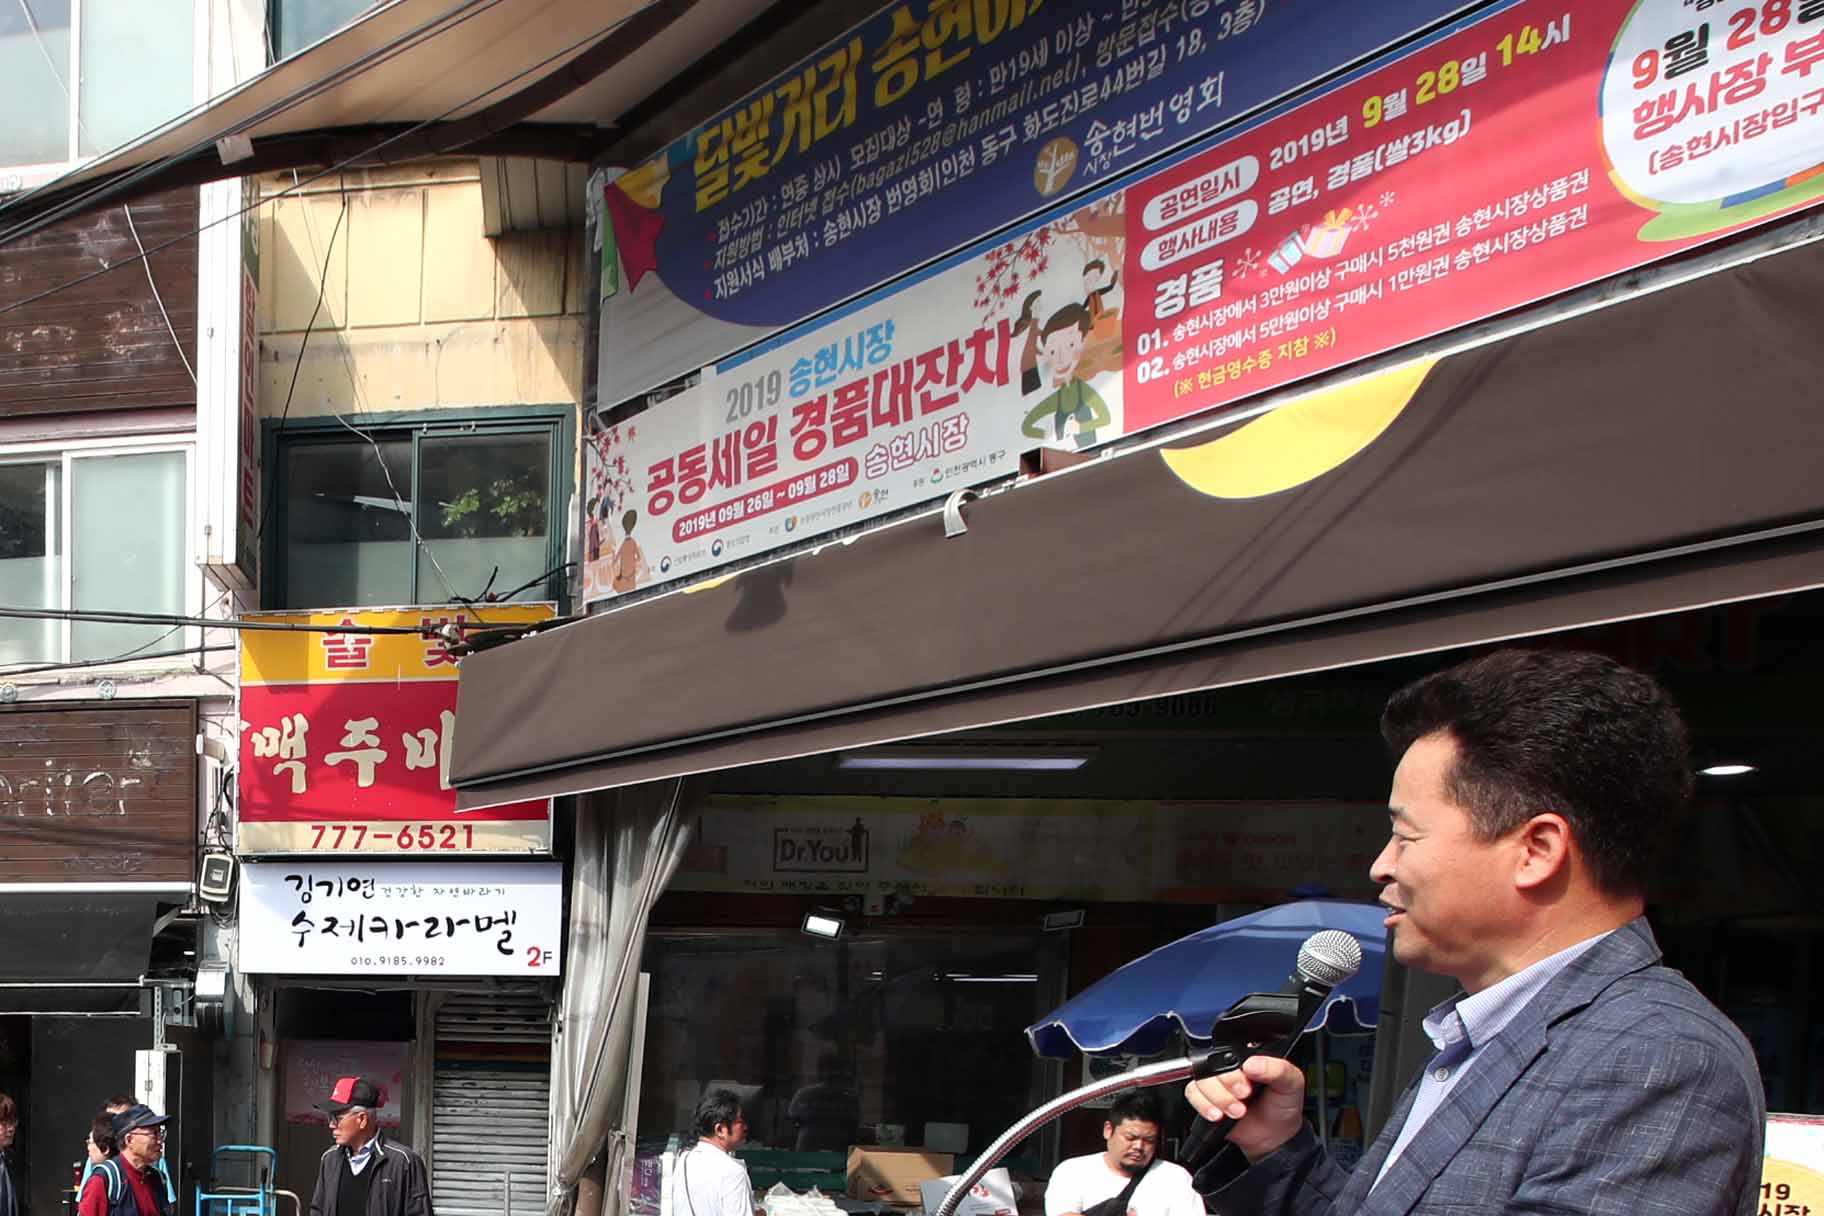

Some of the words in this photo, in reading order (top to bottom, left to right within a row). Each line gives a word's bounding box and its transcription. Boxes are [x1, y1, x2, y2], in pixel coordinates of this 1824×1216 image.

[1632, 22, 1709, 90] 9월
[1269, 115, 1349, 170] 2019년
[1362, 88, 1408, 128] 9월
[1415, 52, 1487, 105] 28일
[1496, 13, 1571, 67] 14시
[1632, 52, 1773, 141] 행사장
[824, 195, 882, 247] 송현시장
[1160, 165, 1240, 220] 공연일시
[1137, 328, 1169, 356] 01.
[1172, 296, 1257, 341] 송현시장에서
[1334, 248, 1384, 282] 구매시
[1455, 167, 1590, 238] 송현시장상품권
[1158, 210, 1239, 261] 행사내용
[1137, 356, 1170, 384] 02.
[1172, 325, 1257, 371] 송현시장에서
[1334, 279, 1384, 312] 구매시
[1454, 204, 1589, 271] 송현시장상품권
[1154, 258, 1224, 320] 경품
[726, 370, 782, 424] 2019
[789, 319, 896, 398] 송현시장
[1198, 351, 1273, 391] 현금영수증
[647, 414, 778, 517] 공동세일
[790, 318, 1012, 462] 경품대잔치
[865, 412, 970, 480] 송현시장
[679, 512, 716, 537] 2019년
[718, 503, 745, 523] 09월
[747, 490, 774, 513] 26일
[788, 474, 817, 498] 09월
[819, 462, 849, 488] 28일
[311, 824, 474, 849] 777-6521
[292, 910, 516, 956] 수제카라멜
